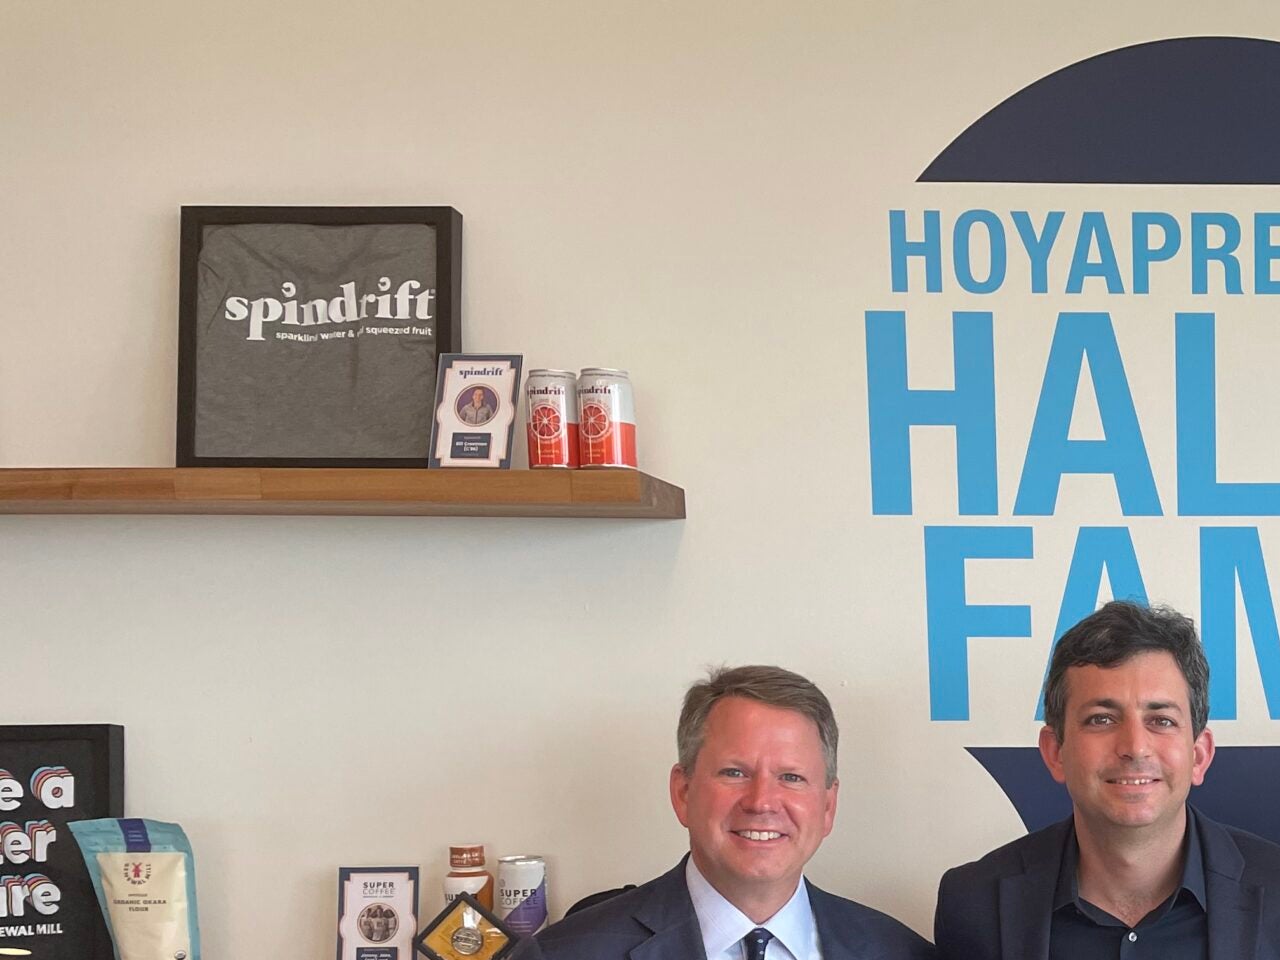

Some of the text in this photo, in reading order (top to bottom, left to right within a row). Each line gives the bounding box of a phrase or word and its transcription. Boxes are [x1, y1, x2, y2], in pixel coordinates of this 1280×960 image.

[225, 277, 434, 341] spindrift
[411, 325, 433, 336] fruit
[459, 367, 504, 379] spindrift
[500, 889, 537, 897] SUPER
[36, 923, 63, 936] MILL
